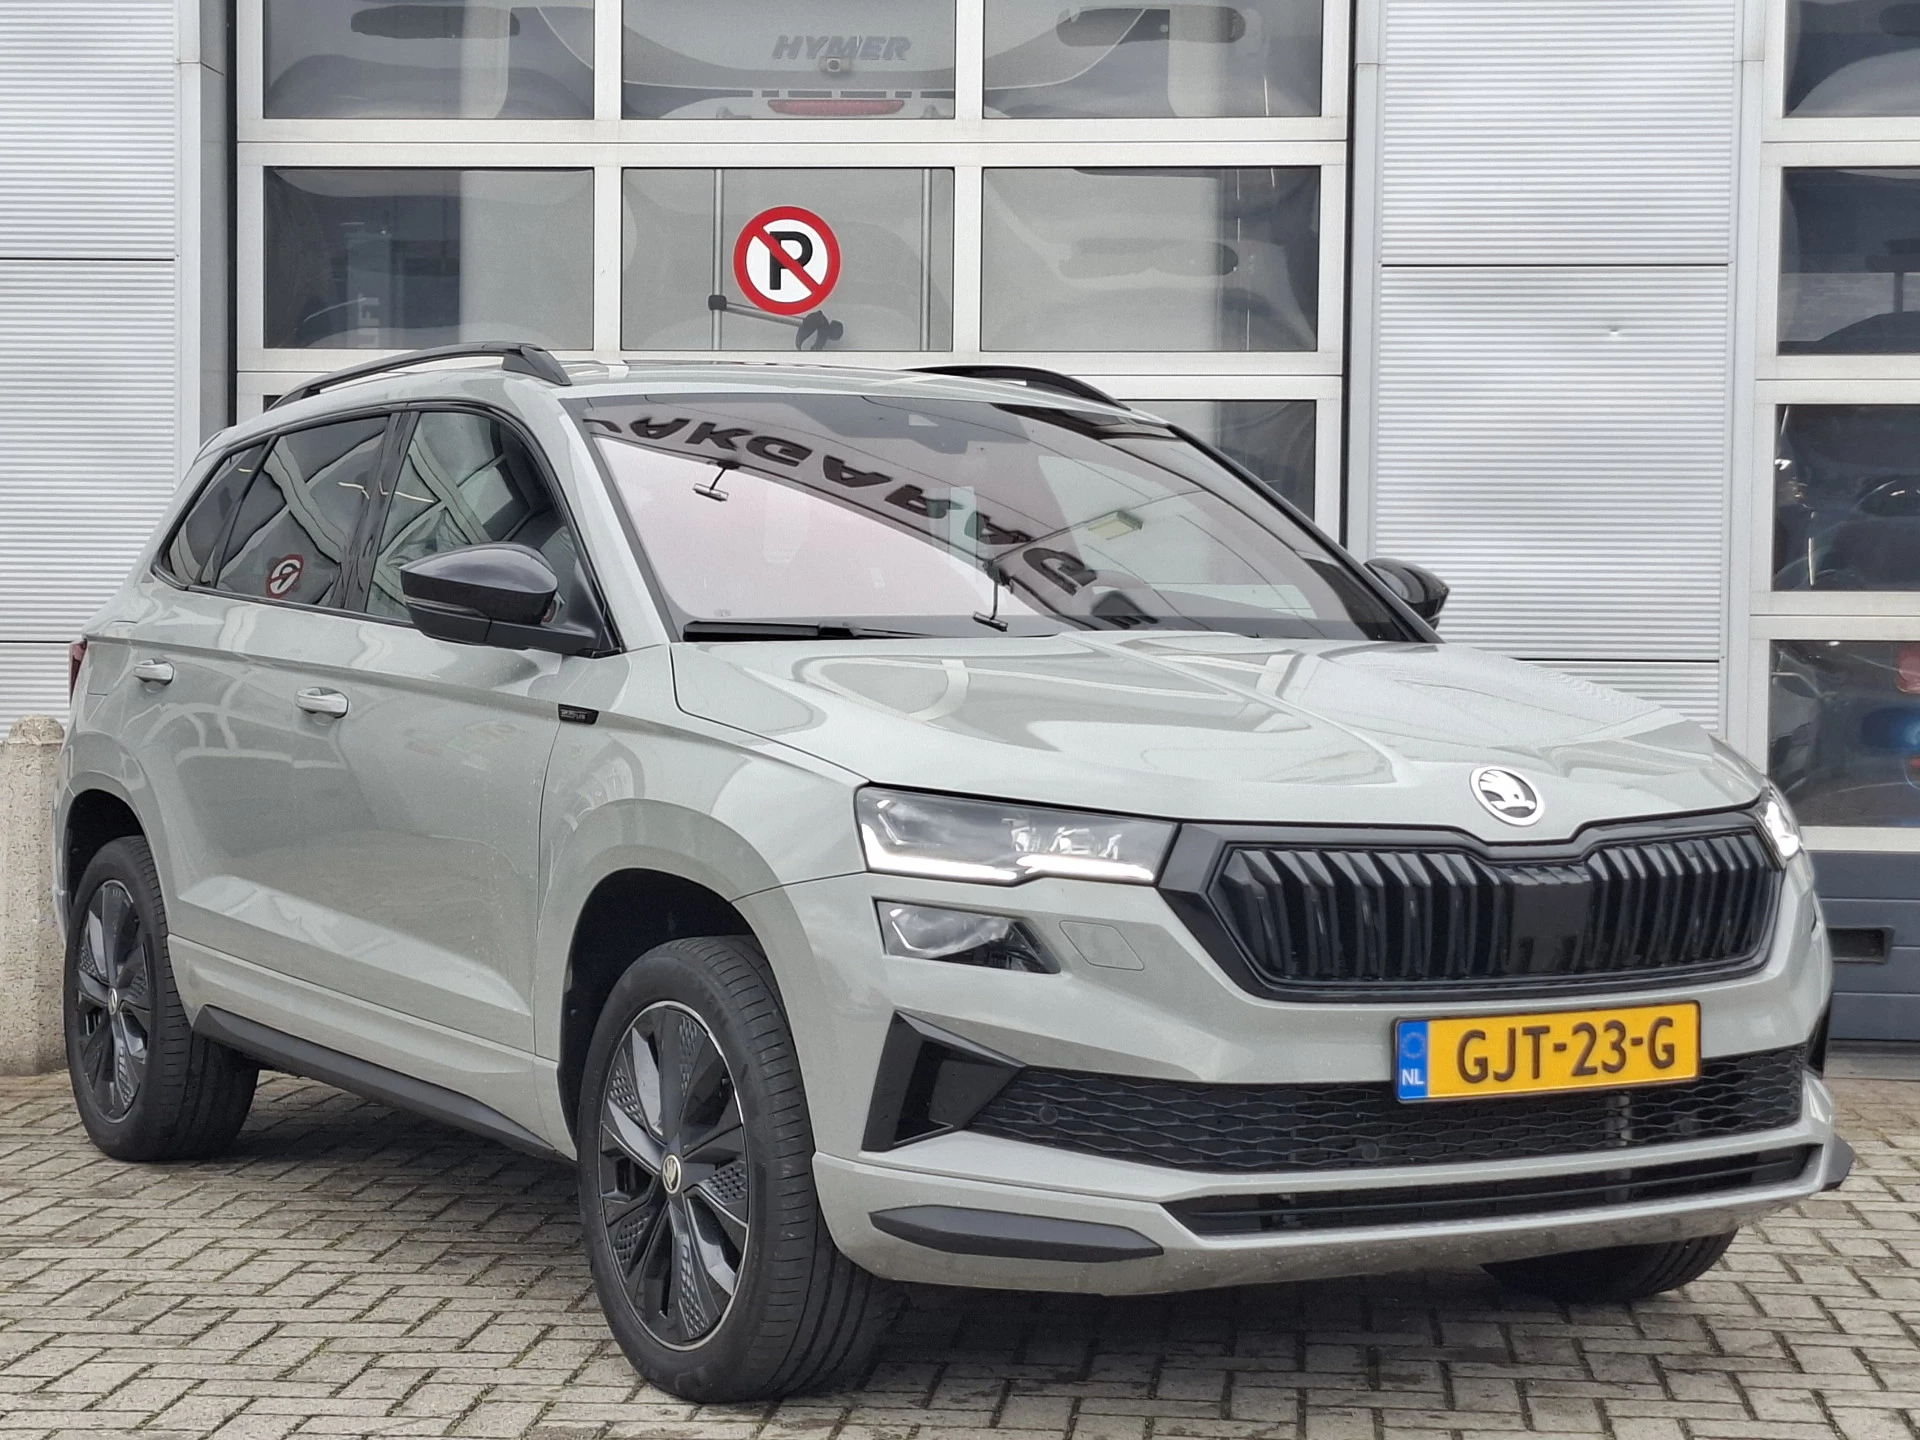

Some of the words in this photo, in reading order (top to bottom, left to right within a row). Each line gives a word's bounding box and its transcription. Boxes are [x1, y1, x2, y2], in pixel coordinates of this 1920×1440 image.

[771, 35, 912, 61] HYMER
[769, 231, 813, 290] P
[1456, 1016, 1676, 1084] GJT-23-G
[1402, 1069, 1424, 1086] NL
